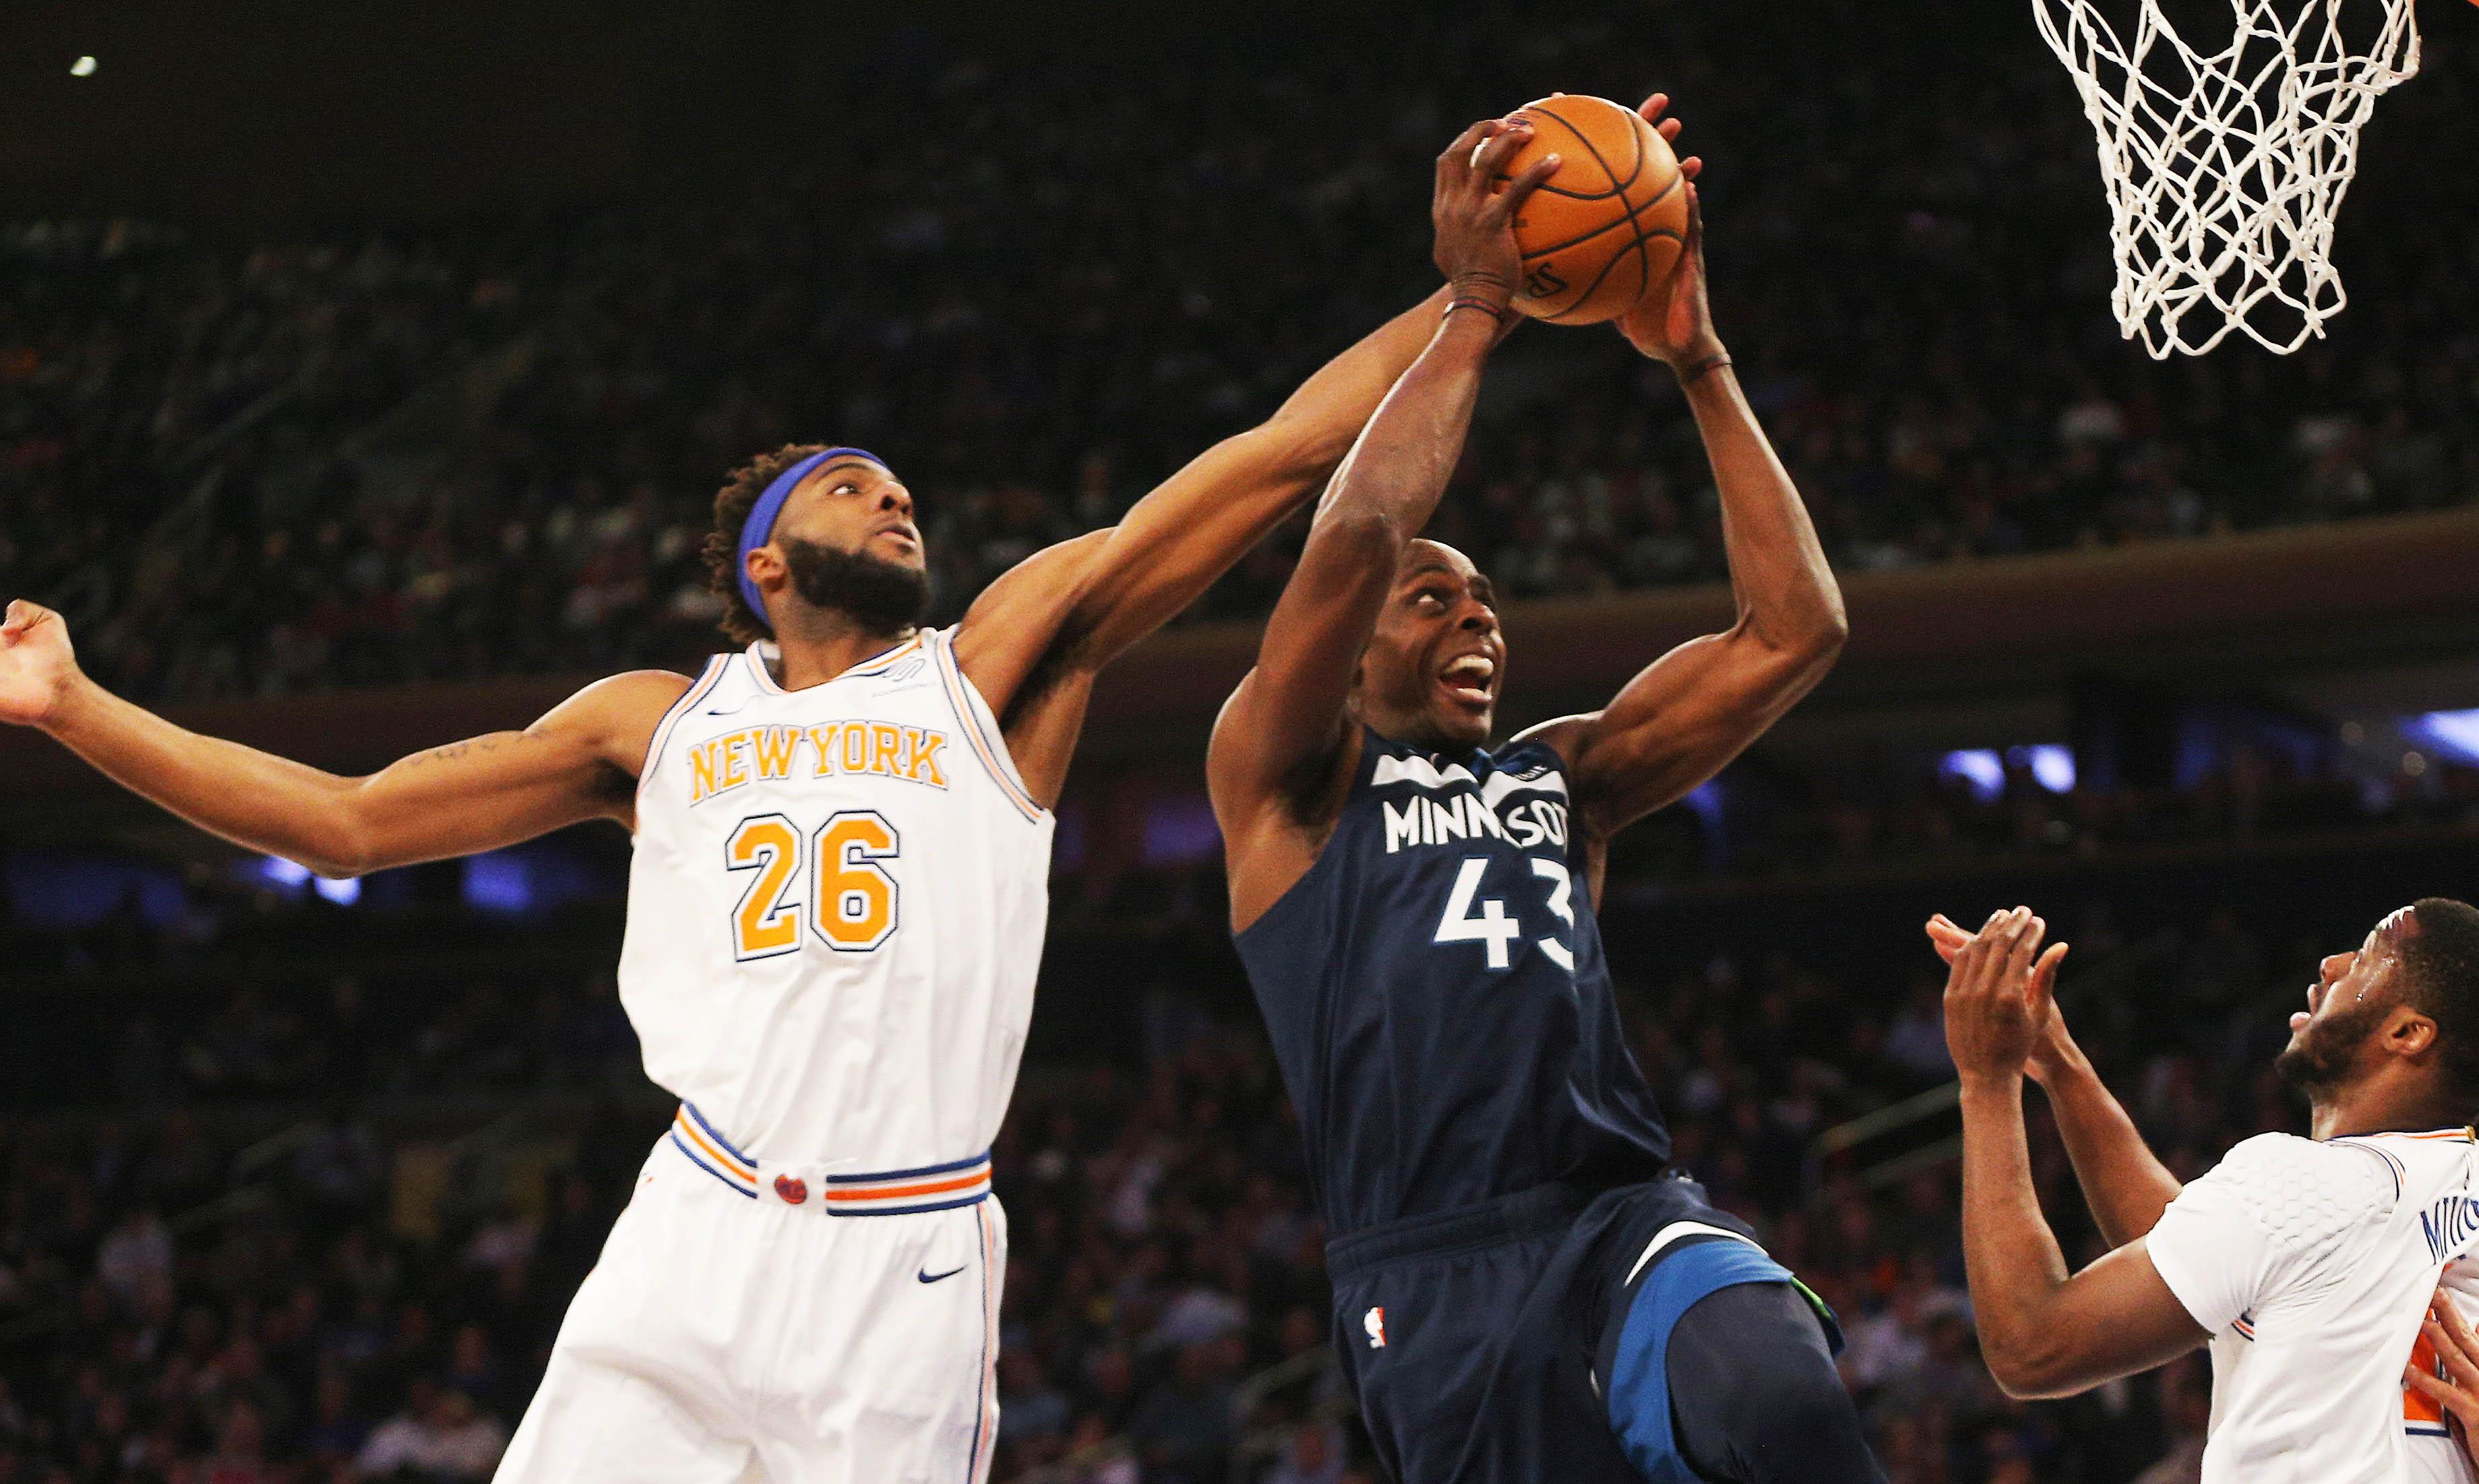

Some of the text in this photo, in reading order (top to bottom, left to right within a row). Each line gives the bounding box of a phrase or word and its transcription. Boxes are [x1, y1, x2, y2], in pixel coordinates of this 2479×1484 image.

[687, 720, 948, 807] NEW YORK
[725, 809, 900, 962] 26
[1434, 857, 1575, 972] 43
